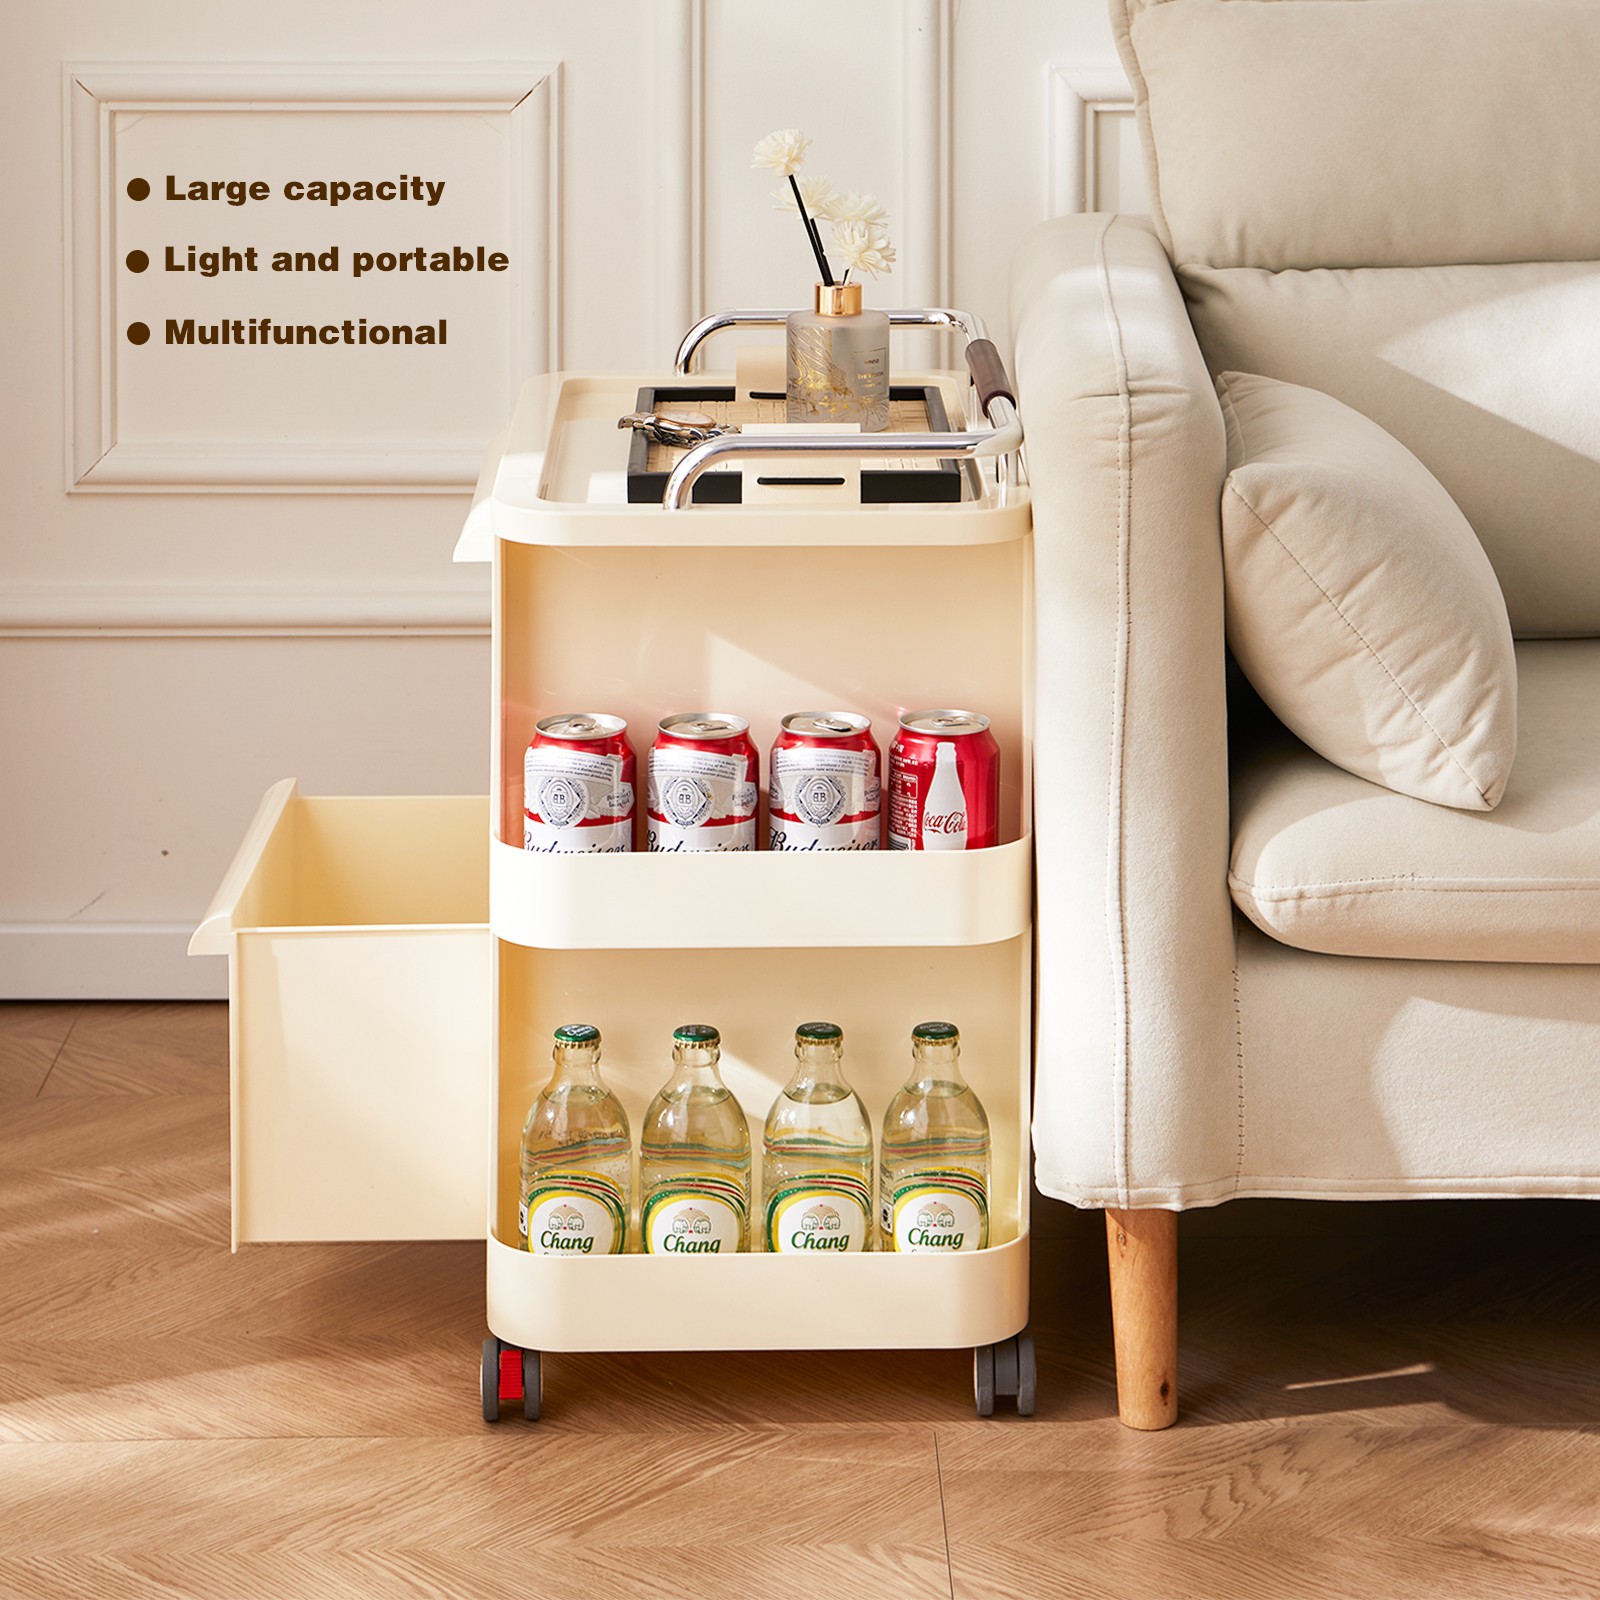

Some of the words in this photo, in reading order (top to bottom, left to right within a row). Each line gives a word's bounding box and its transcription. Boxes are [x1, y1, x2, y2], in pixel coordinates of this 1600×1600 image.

[540, 1230, 595, 1252] Chang
[663, 1233, 722, 1254] Chang
[791, 1230, 851, 1252] Chang
[908, 1227, 965, 1251] Chang
